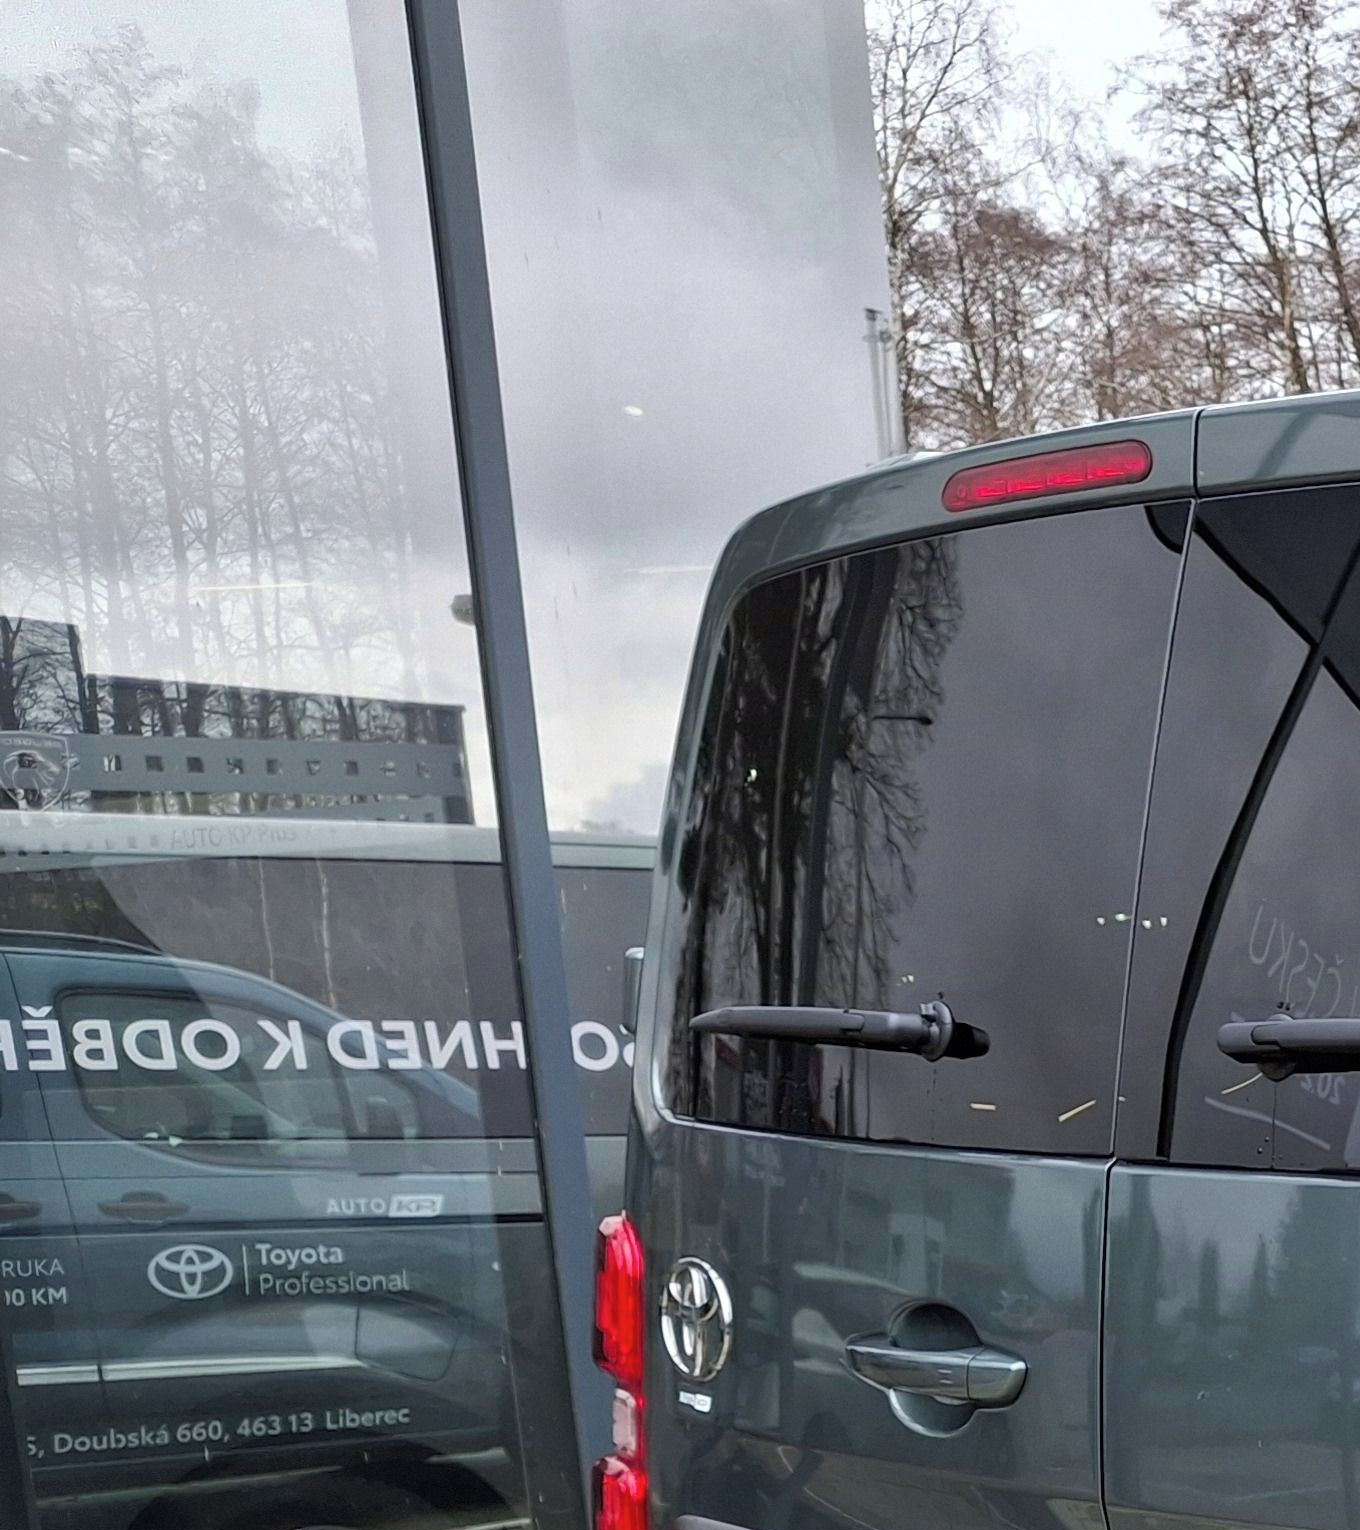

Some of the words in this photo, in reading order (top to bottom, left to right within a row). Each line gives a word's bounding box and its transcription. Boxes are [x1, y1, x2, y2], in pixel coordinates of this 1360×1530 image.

[326, 1197, 385, 1215] AUTO
[255, 1243, 344, 1270] Toyota
[259, 1268, 410, 1296] Professional
[31, 1286, 68, 1306] KM
[53, 1424, 170, 1454] Doubská
[176, 1420, 230, 1444] 660,
[236, 1415, 281, 1437] 463
[288, 1411, 314, 1434] 13
[325, 1407, 411, 1431] Liberec
